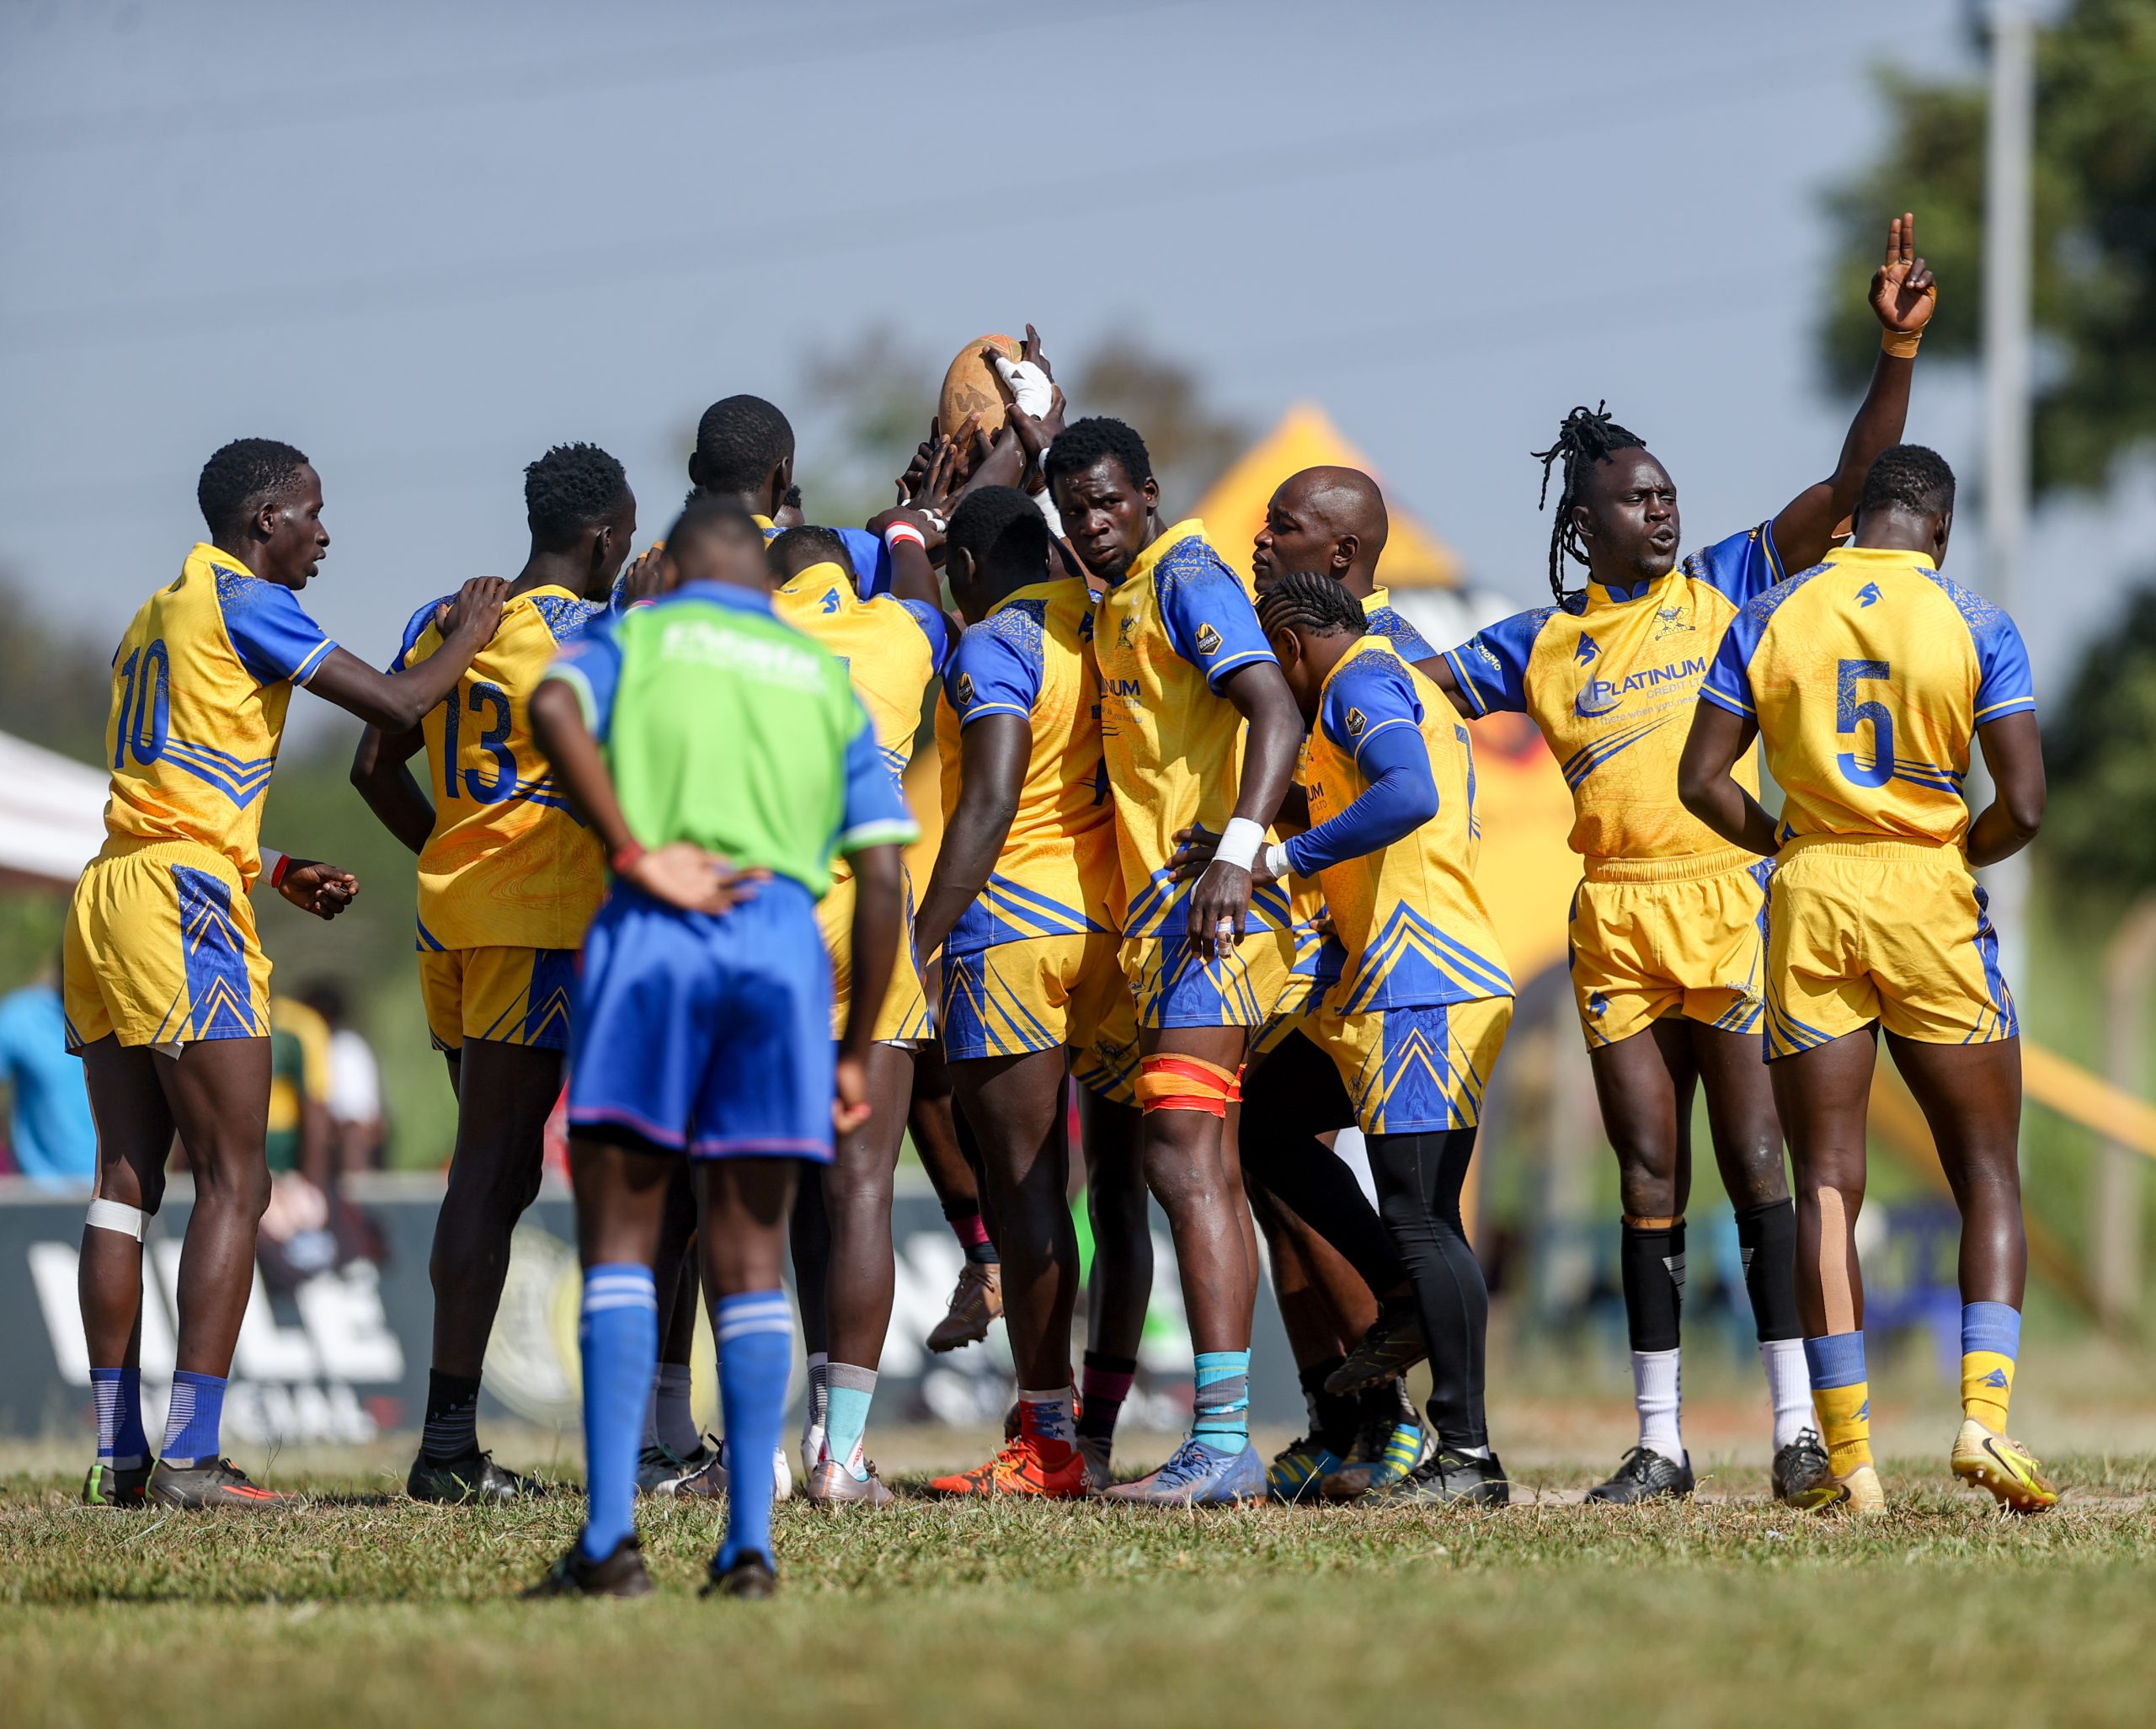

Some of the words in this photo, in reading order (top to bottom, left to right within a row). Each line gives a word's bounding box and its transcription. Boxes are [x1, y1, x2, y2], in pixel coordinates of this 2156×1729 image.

[1478, 644, 1502, 671] MoMo
[1593, 656, 1706, 702] PLATINUM
[115, 638, 169, 766] 10
[1600, 713, 1625, 725] There
[1627, 706, 1654, 719] when
[1657, 700, 1673, 713] you
[1646, 680, 1686, 700] CREDIT
[445, 680, 518, 805] 13
[1836, 659, 1895, 789] 5
